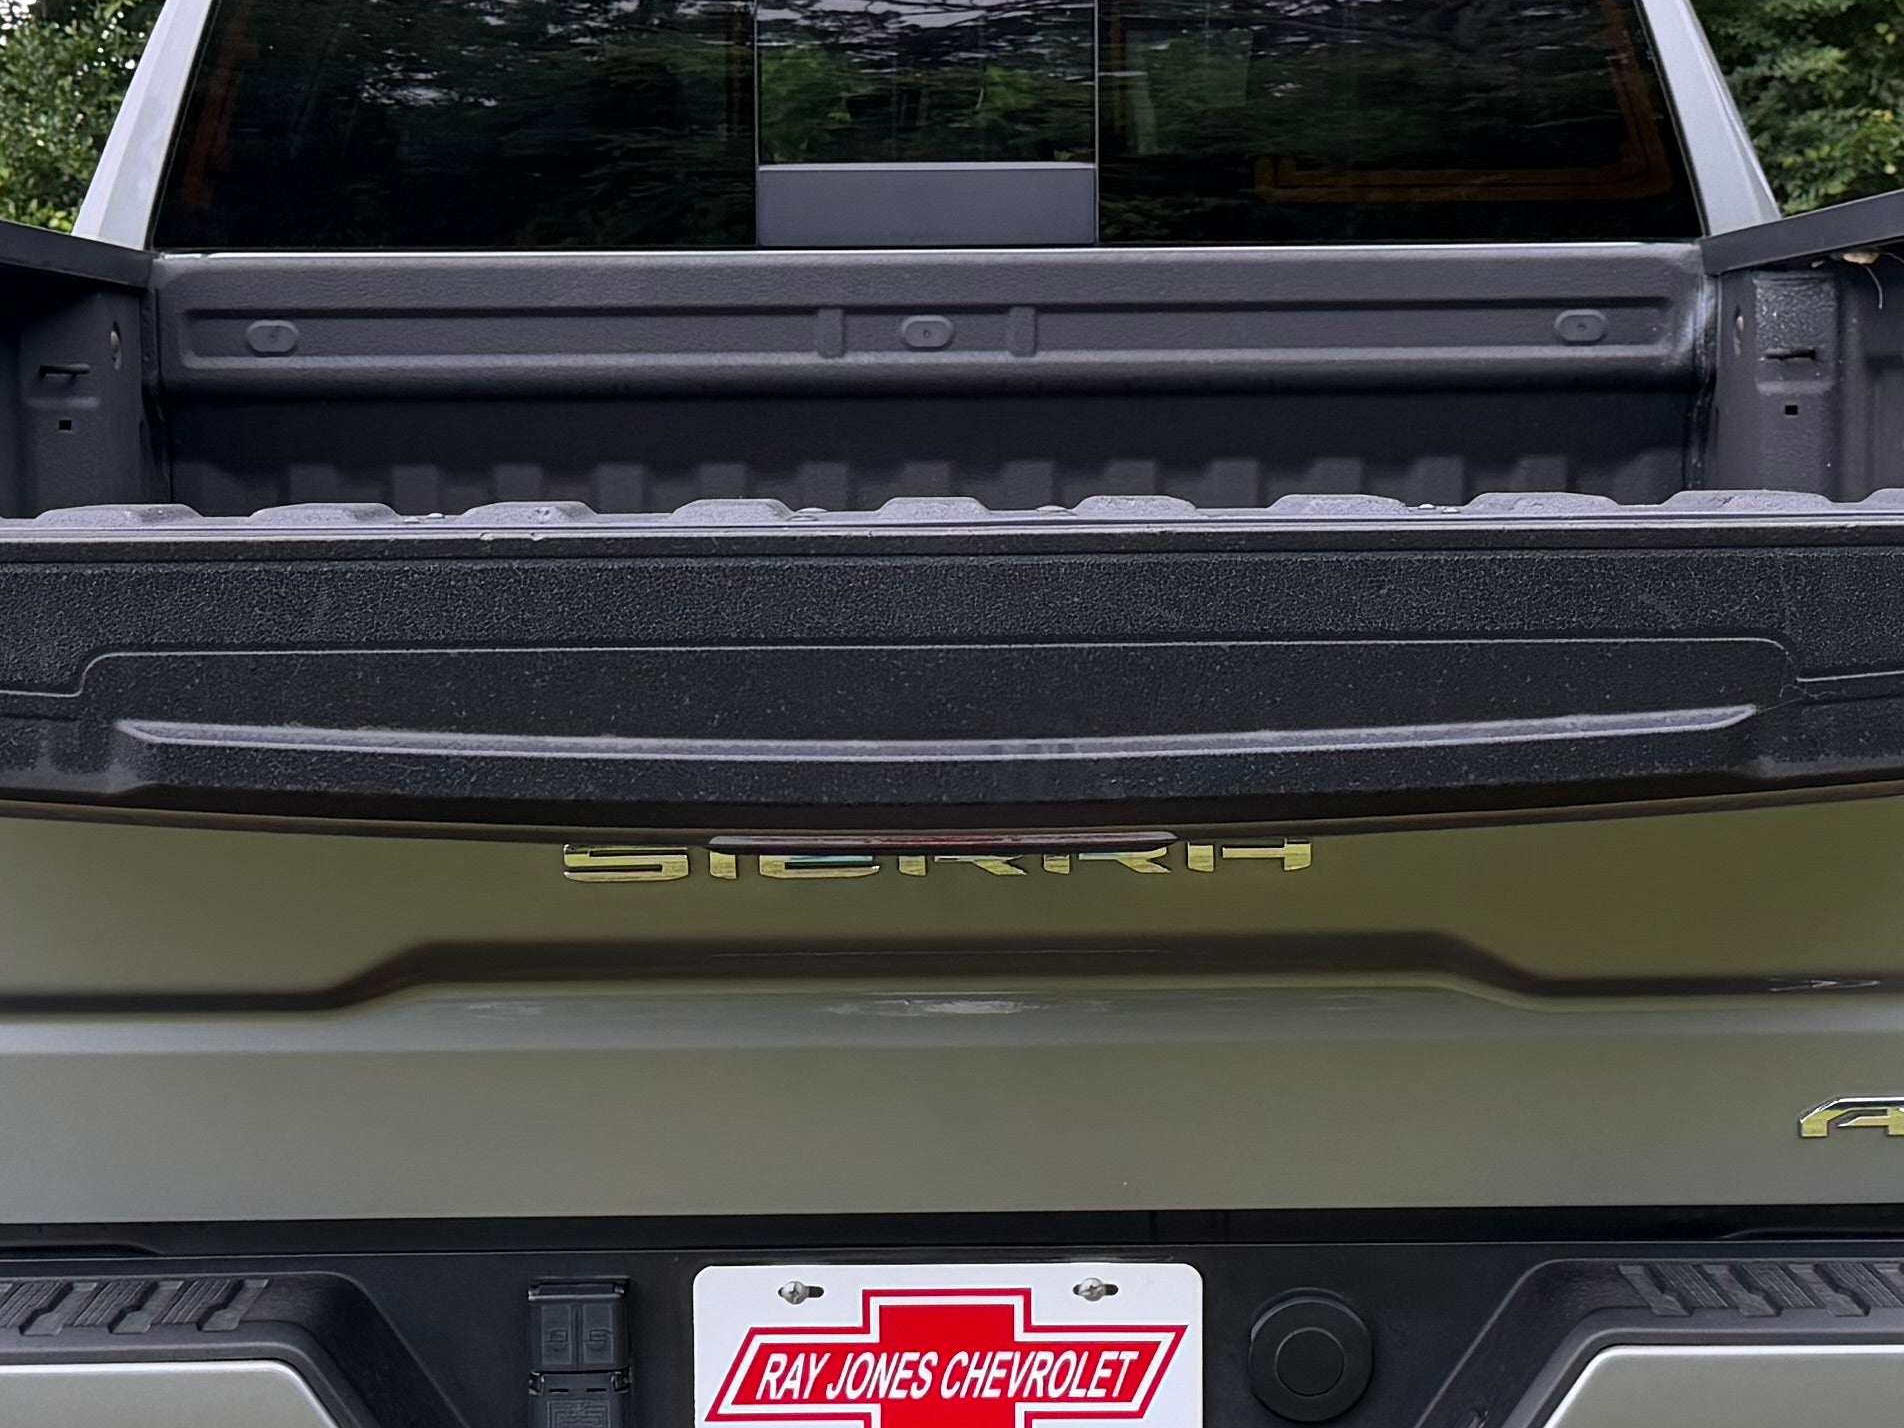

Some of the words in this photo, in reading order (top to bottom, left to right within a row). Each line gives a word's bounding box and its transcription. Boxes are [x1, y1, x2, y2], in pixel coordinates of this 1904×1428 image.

[755, 1352, 832, 1400] RAY
[825, 1351, 938, 1399] JONES
[940, 1350, 1140, 1399] CHEVROLET
